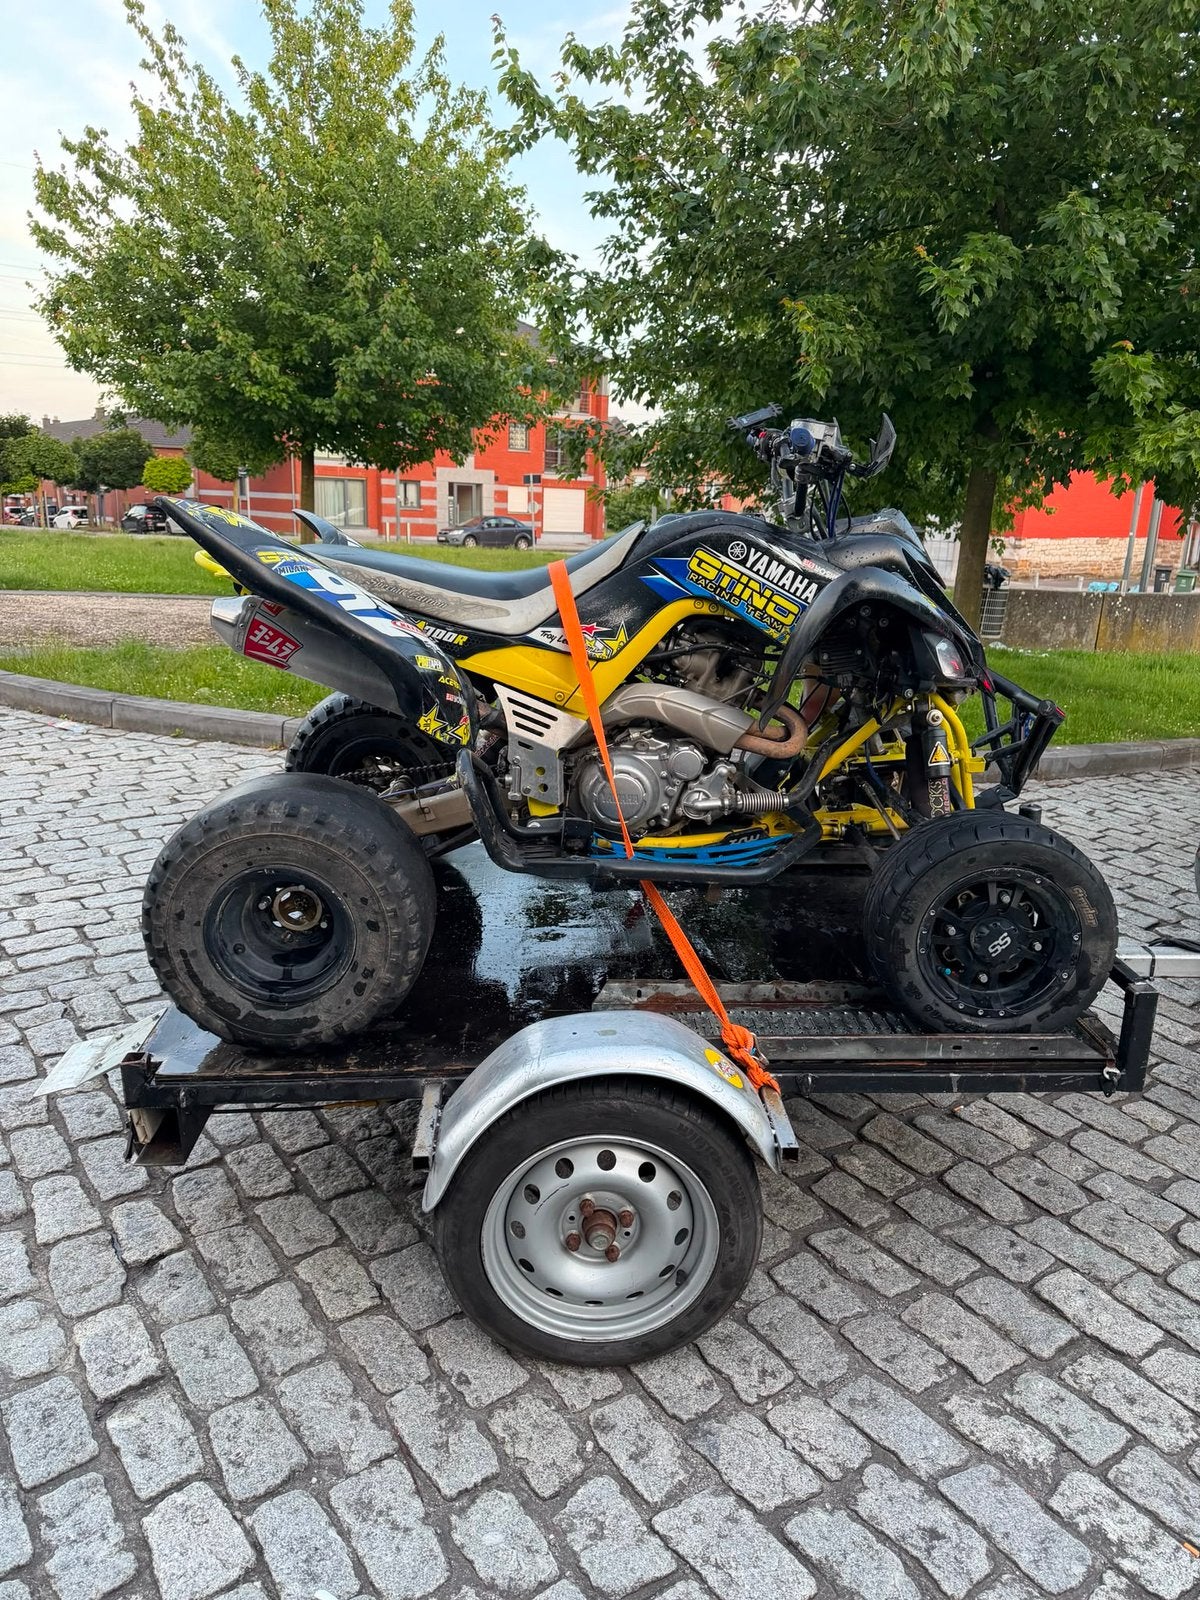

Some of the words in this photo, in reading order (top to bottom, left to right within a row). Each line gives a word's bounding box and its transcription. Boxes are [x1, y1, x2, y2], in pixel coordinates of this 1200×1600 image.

[745, 547, 819, 604] YAMAHA
[689, 573, 740, 606] RACING
[746, 606, 784, 632] TEAM
[250, 624, 296, 658] ヨシムラ
[425, 626, 469, 646] 700R
[541, 630, 557, 643] Troy
